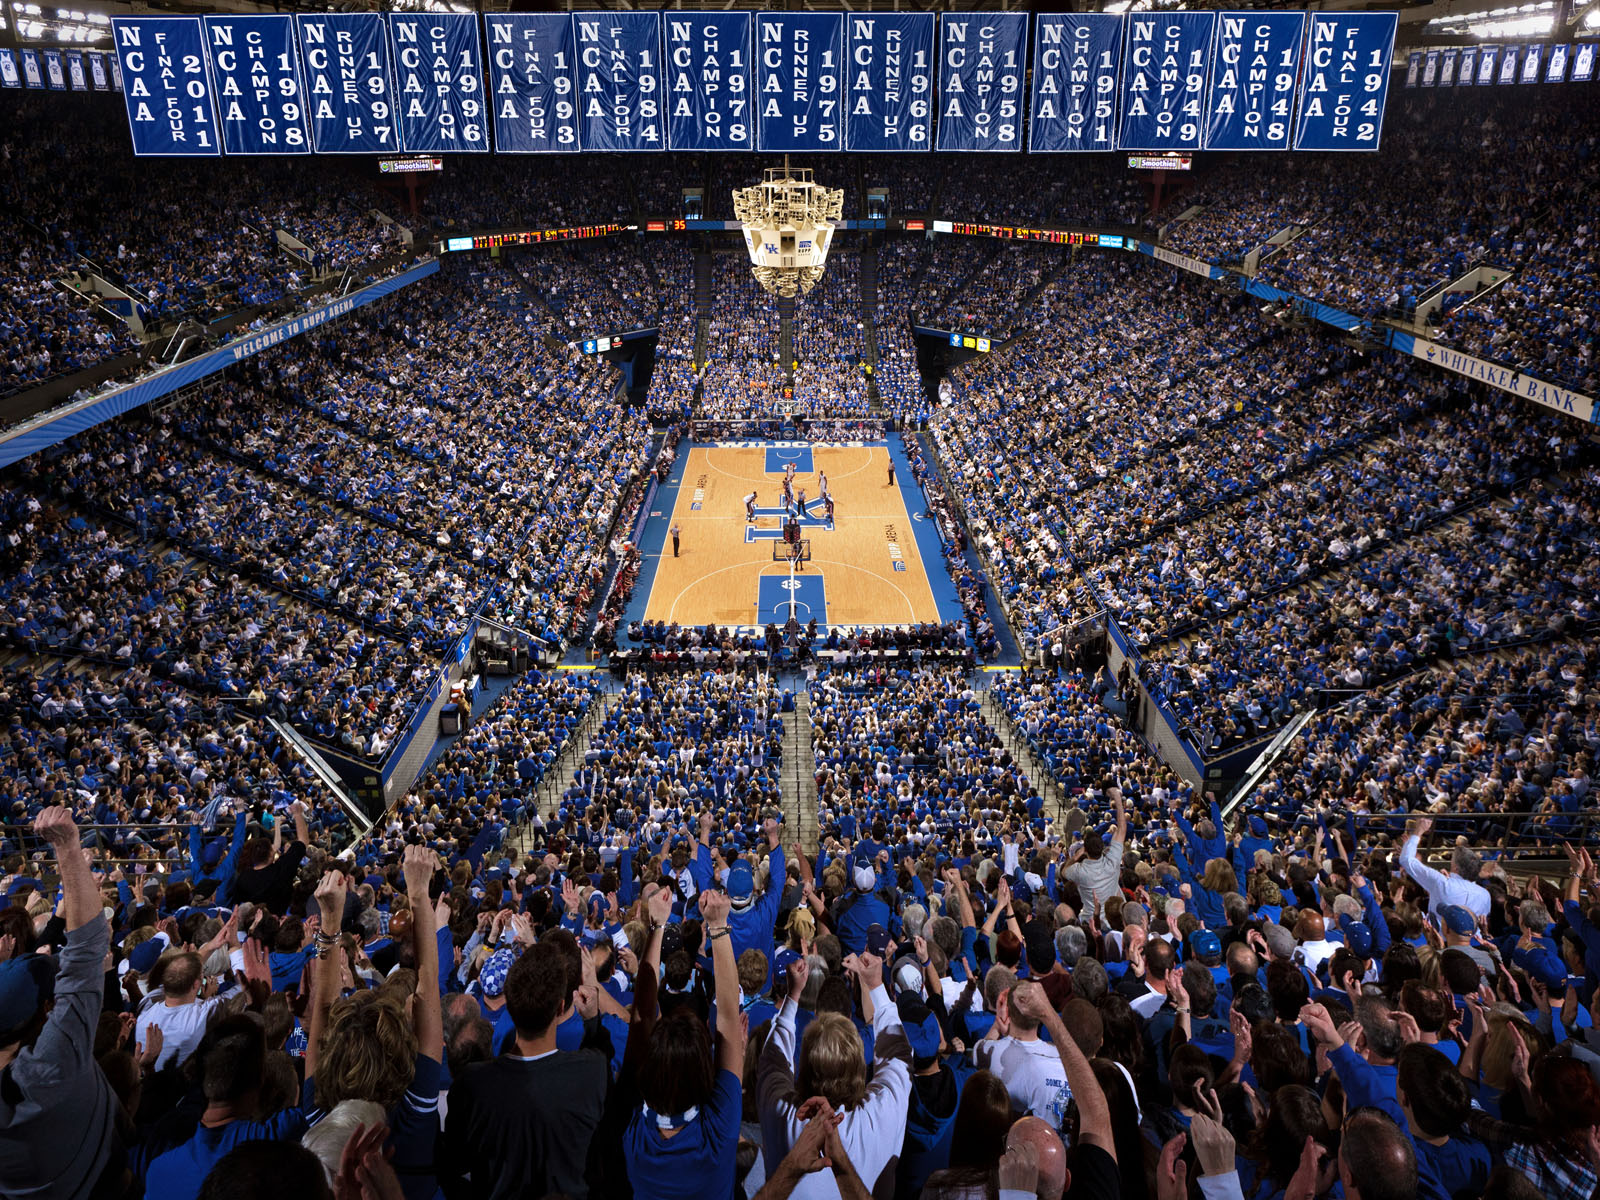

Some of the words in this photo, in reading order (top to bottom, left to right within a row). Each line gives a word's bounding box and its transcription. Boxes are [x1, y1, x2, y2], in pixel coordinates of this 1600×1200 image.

[119, 26, 155, 122] NCAA
[155, 32, 176, 90] FINAL
[167, 97, 186, 142] FOUR
[182, 55, 212, 147] 2011
[211, 25, 247, 121] NCAA
[246, 31, 277, 144] CHAMPION
[277, 53, 304, 146] 1998
[305, 23, 336, 119] NCAA
[336, 31, 360, 104] RUNNER
[367, 52, 391, 143] 1997
[397, 22, 426, 118] NCAA
[430, 27, 455, 140] CHAMPION
[460, 50, 482, 142] 1996
[492, 23, 519, 119] NCAA
[524, 30, 542, 85] FINAL
[554, 52, 575, 144] 1993
[579, 22, 605, 117] NCAA
[610, 27, 627, 83] FINAL
[638, 50, 659, 142] 1984
[671, 21, 693, 117] NCAA
[703, 25, 721, 138] CHAMPION
[728, 50, 747, 141] 1978
[762, 22, 784, 118] NCAA
[793, 29, 809, 101] RUNNER
[818, 50, 836, 141] 1975
[852, 20, 876, 115] NCAA
[884, 29, 901, 102] RUNNER
[909, 50, 929, 142] 1966
[944, 22, 969, 118] NCAA
[974, 26, 994, 139] CHAMPION
[997, 50, 1018, 142] 1958
[1037, 24, 1064, 119] NCAA
[1067, 26, 1091, 139] CHAMPION
[1094, 51, 1114, 142] 1951
[1128, 21, 1156, 116] NCAA
[1156, 25, 1181, 138] CHAMPION
[1180, 49, 1203, 141] 1949
[1215, 19, 1246, 114] NCAA
[1244, 25, 1272, 137] CHAMPION
[1267, 49, 1293, 140] 1948
[1305, 22, 1338, 117] NCAA
[1340, 28, 1360, 83] FINAL
[1356, 50, 1382, 141] 1942
[347, 117, 363, 140] UP
[528, 96, 546, 139] FOUR
[614, 94, 632, 137] FOUR
[793, 115, 807, 137] UP
[884, 115, 898, 138] UP
[1332, 94, 1351, 137] FOUR
[394, 162, 429, 170] Smoothies
[1141, 160, 1176, 168] Smoothies
[674, 220, 686, 230] 35
[765, 243, 779, 254] UK
[1190, 261, 1206, 275] BANK
[233, 329, 284, 359] WELCOME
[288, 323, 299, 336] TO
[303, 311, 326, 329] RUPP
[329, 299, 354, 318] ARENA
[1438, 349, 1520, 391] WHITAKER
[1527, 381, 1578, 412] BANK
